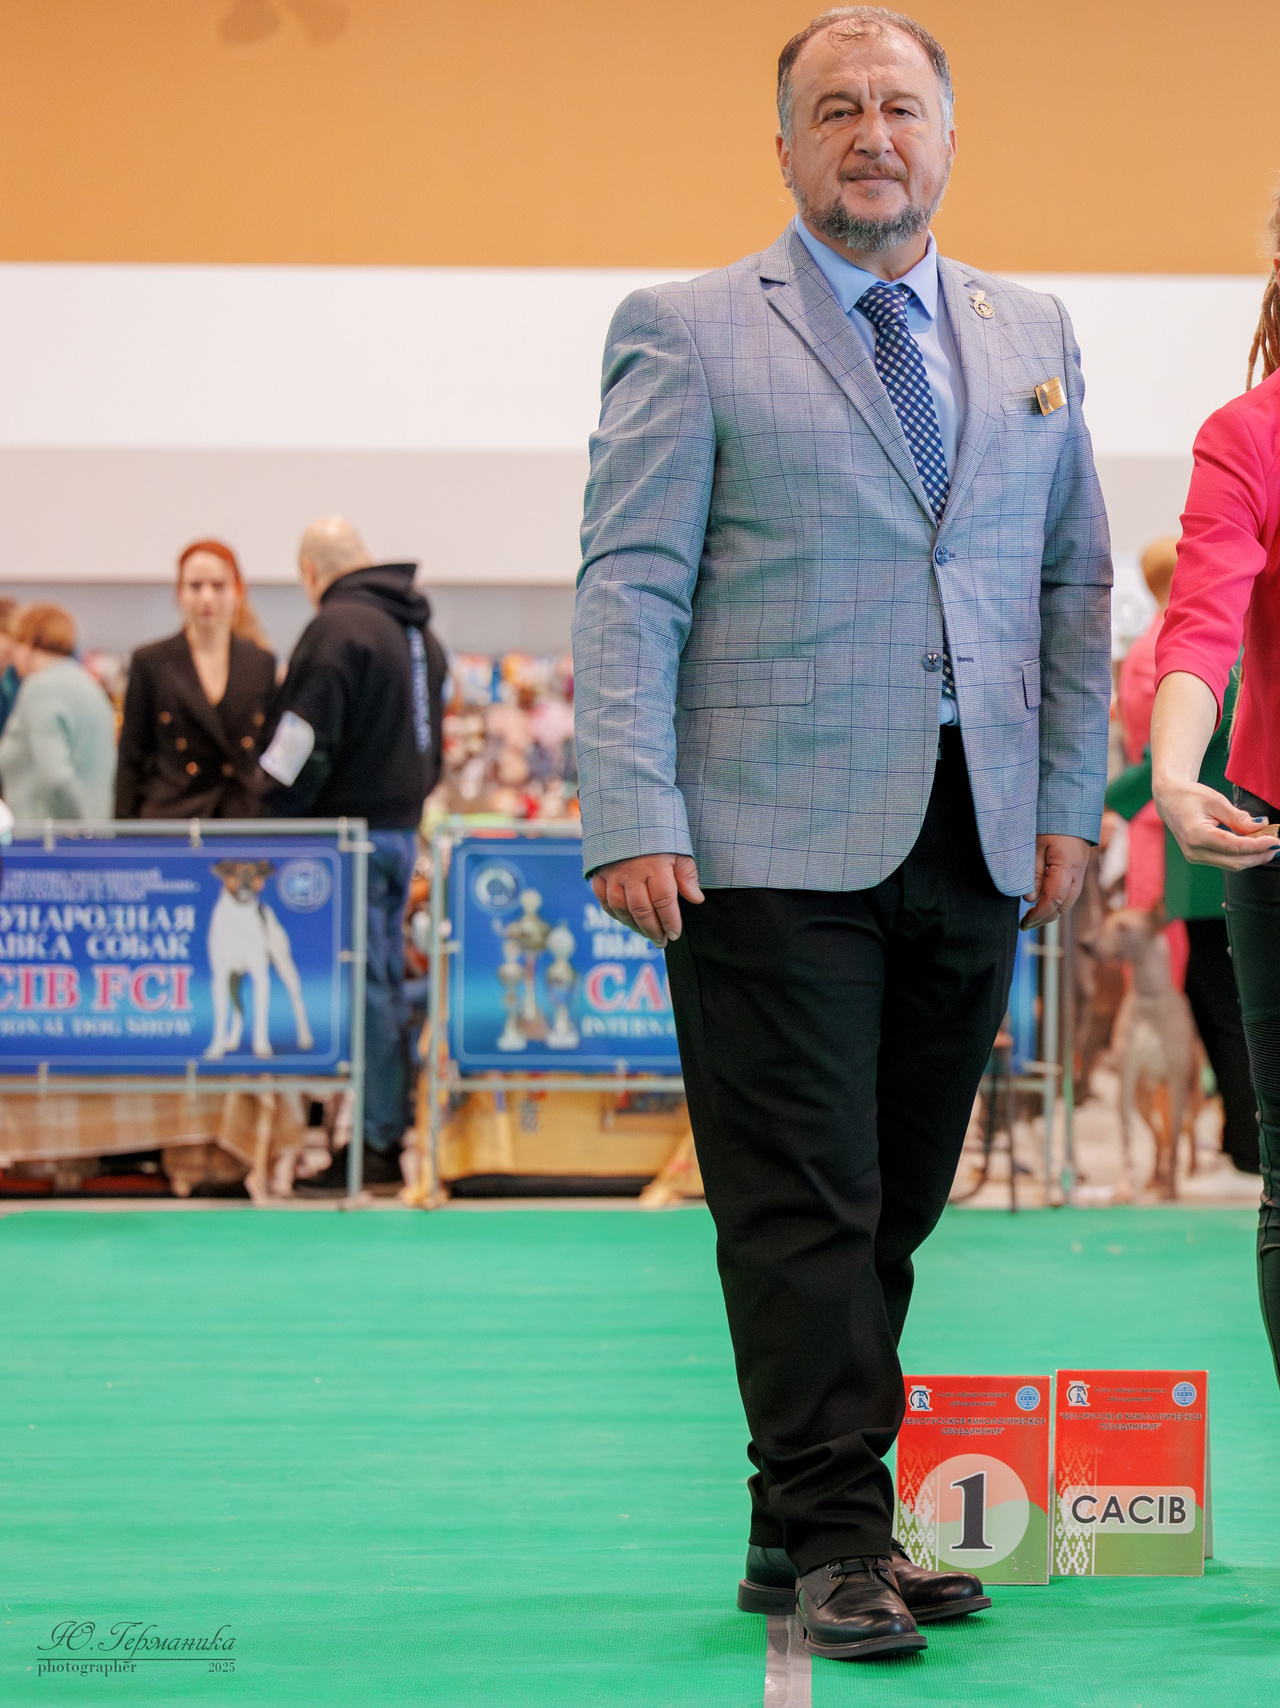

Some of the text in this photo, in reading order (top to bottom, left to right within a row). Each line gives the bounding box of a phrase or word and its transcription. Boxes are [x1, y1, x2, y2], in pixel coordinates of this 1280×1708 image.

[86, 932, 191, 960] СОБАК
[92, 964, 194, 1013] FCI
[584, 962, 673, 1013] CA
[967, 1417, 1046, 1425] КИНОЛОГИЧЕСКОЕ
[1125, 1412, 1202, 1421] КИНОЛОГИЧЕСКОЕ
[950, 1472, 993, 1551] 1
[1071, 1495, 1186, 1524] CACIB
